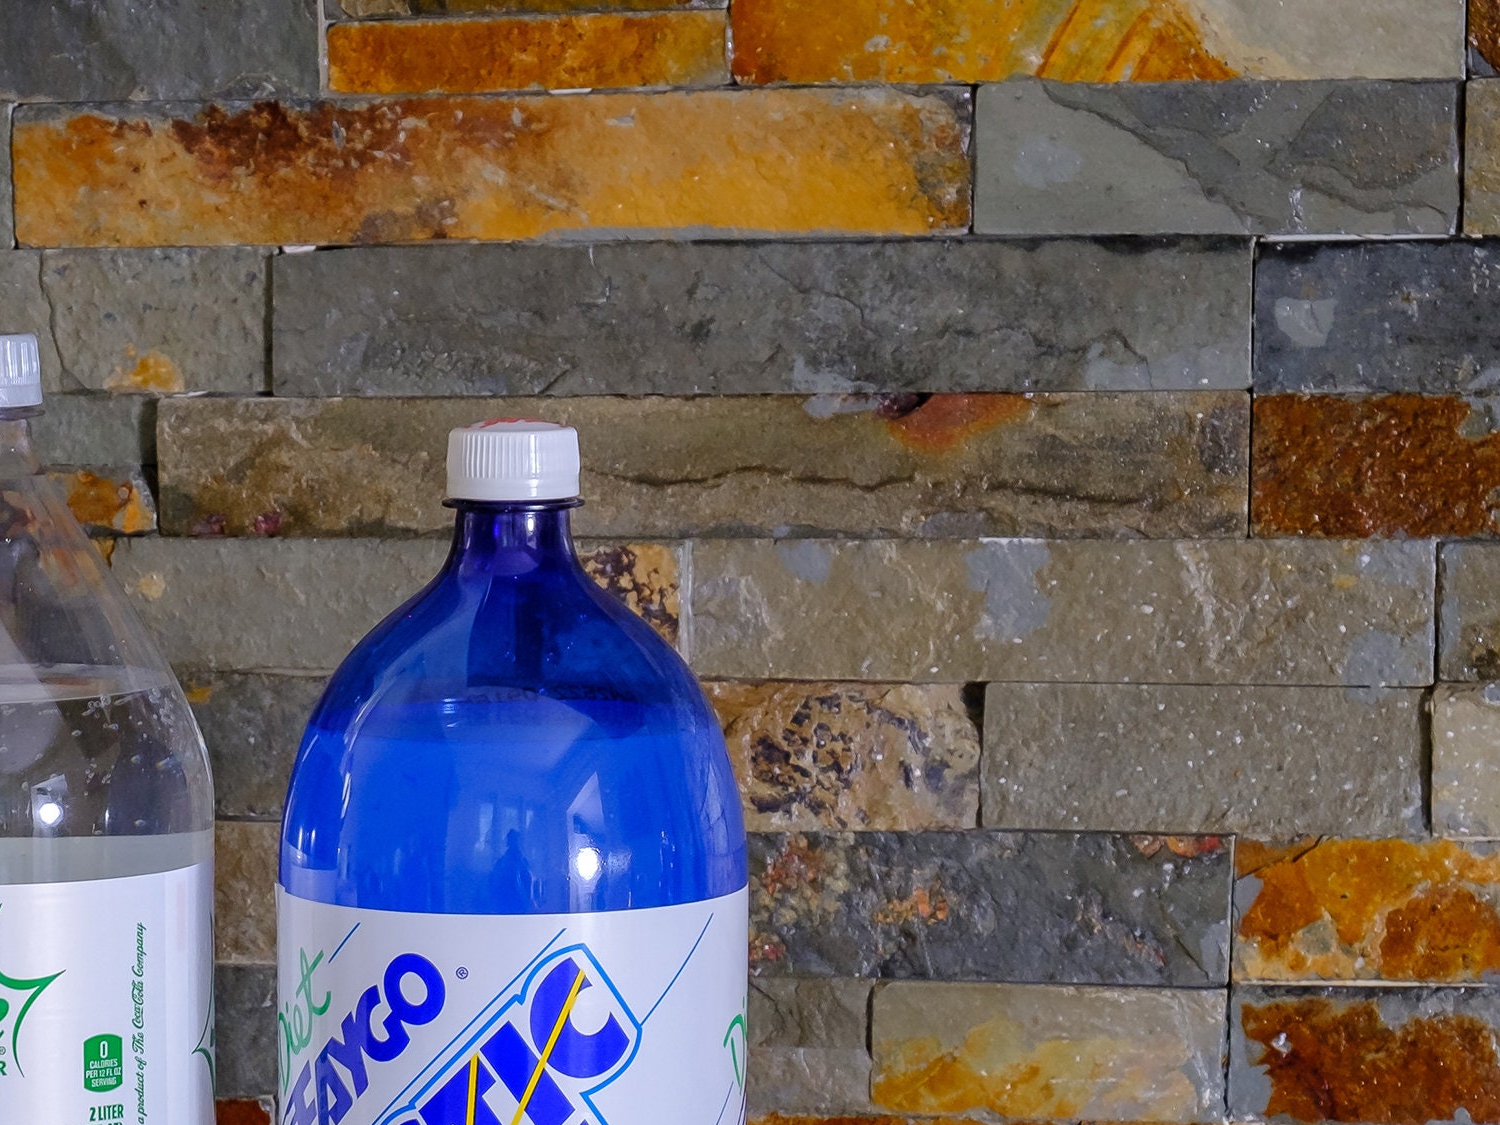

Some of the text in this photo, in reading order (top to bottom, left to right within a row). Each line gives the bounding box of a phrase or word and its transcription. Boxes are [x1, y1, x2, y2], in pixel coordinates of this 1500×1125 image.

[131, 922, 147, 978] Company
[100, 1040, 108, 1059] 0
[131, 1032, 145, 1055] The
[89, 1058, 118, 1069] CALORIES
[134, 1055, 147, 1071] of
[85, 1069, 98, 1079] PER
[91, 1076, 117, 1088] SERVING
[134, 1071, 147, 1117] product
[89, 1103, 124, 1122] 2 LITER
